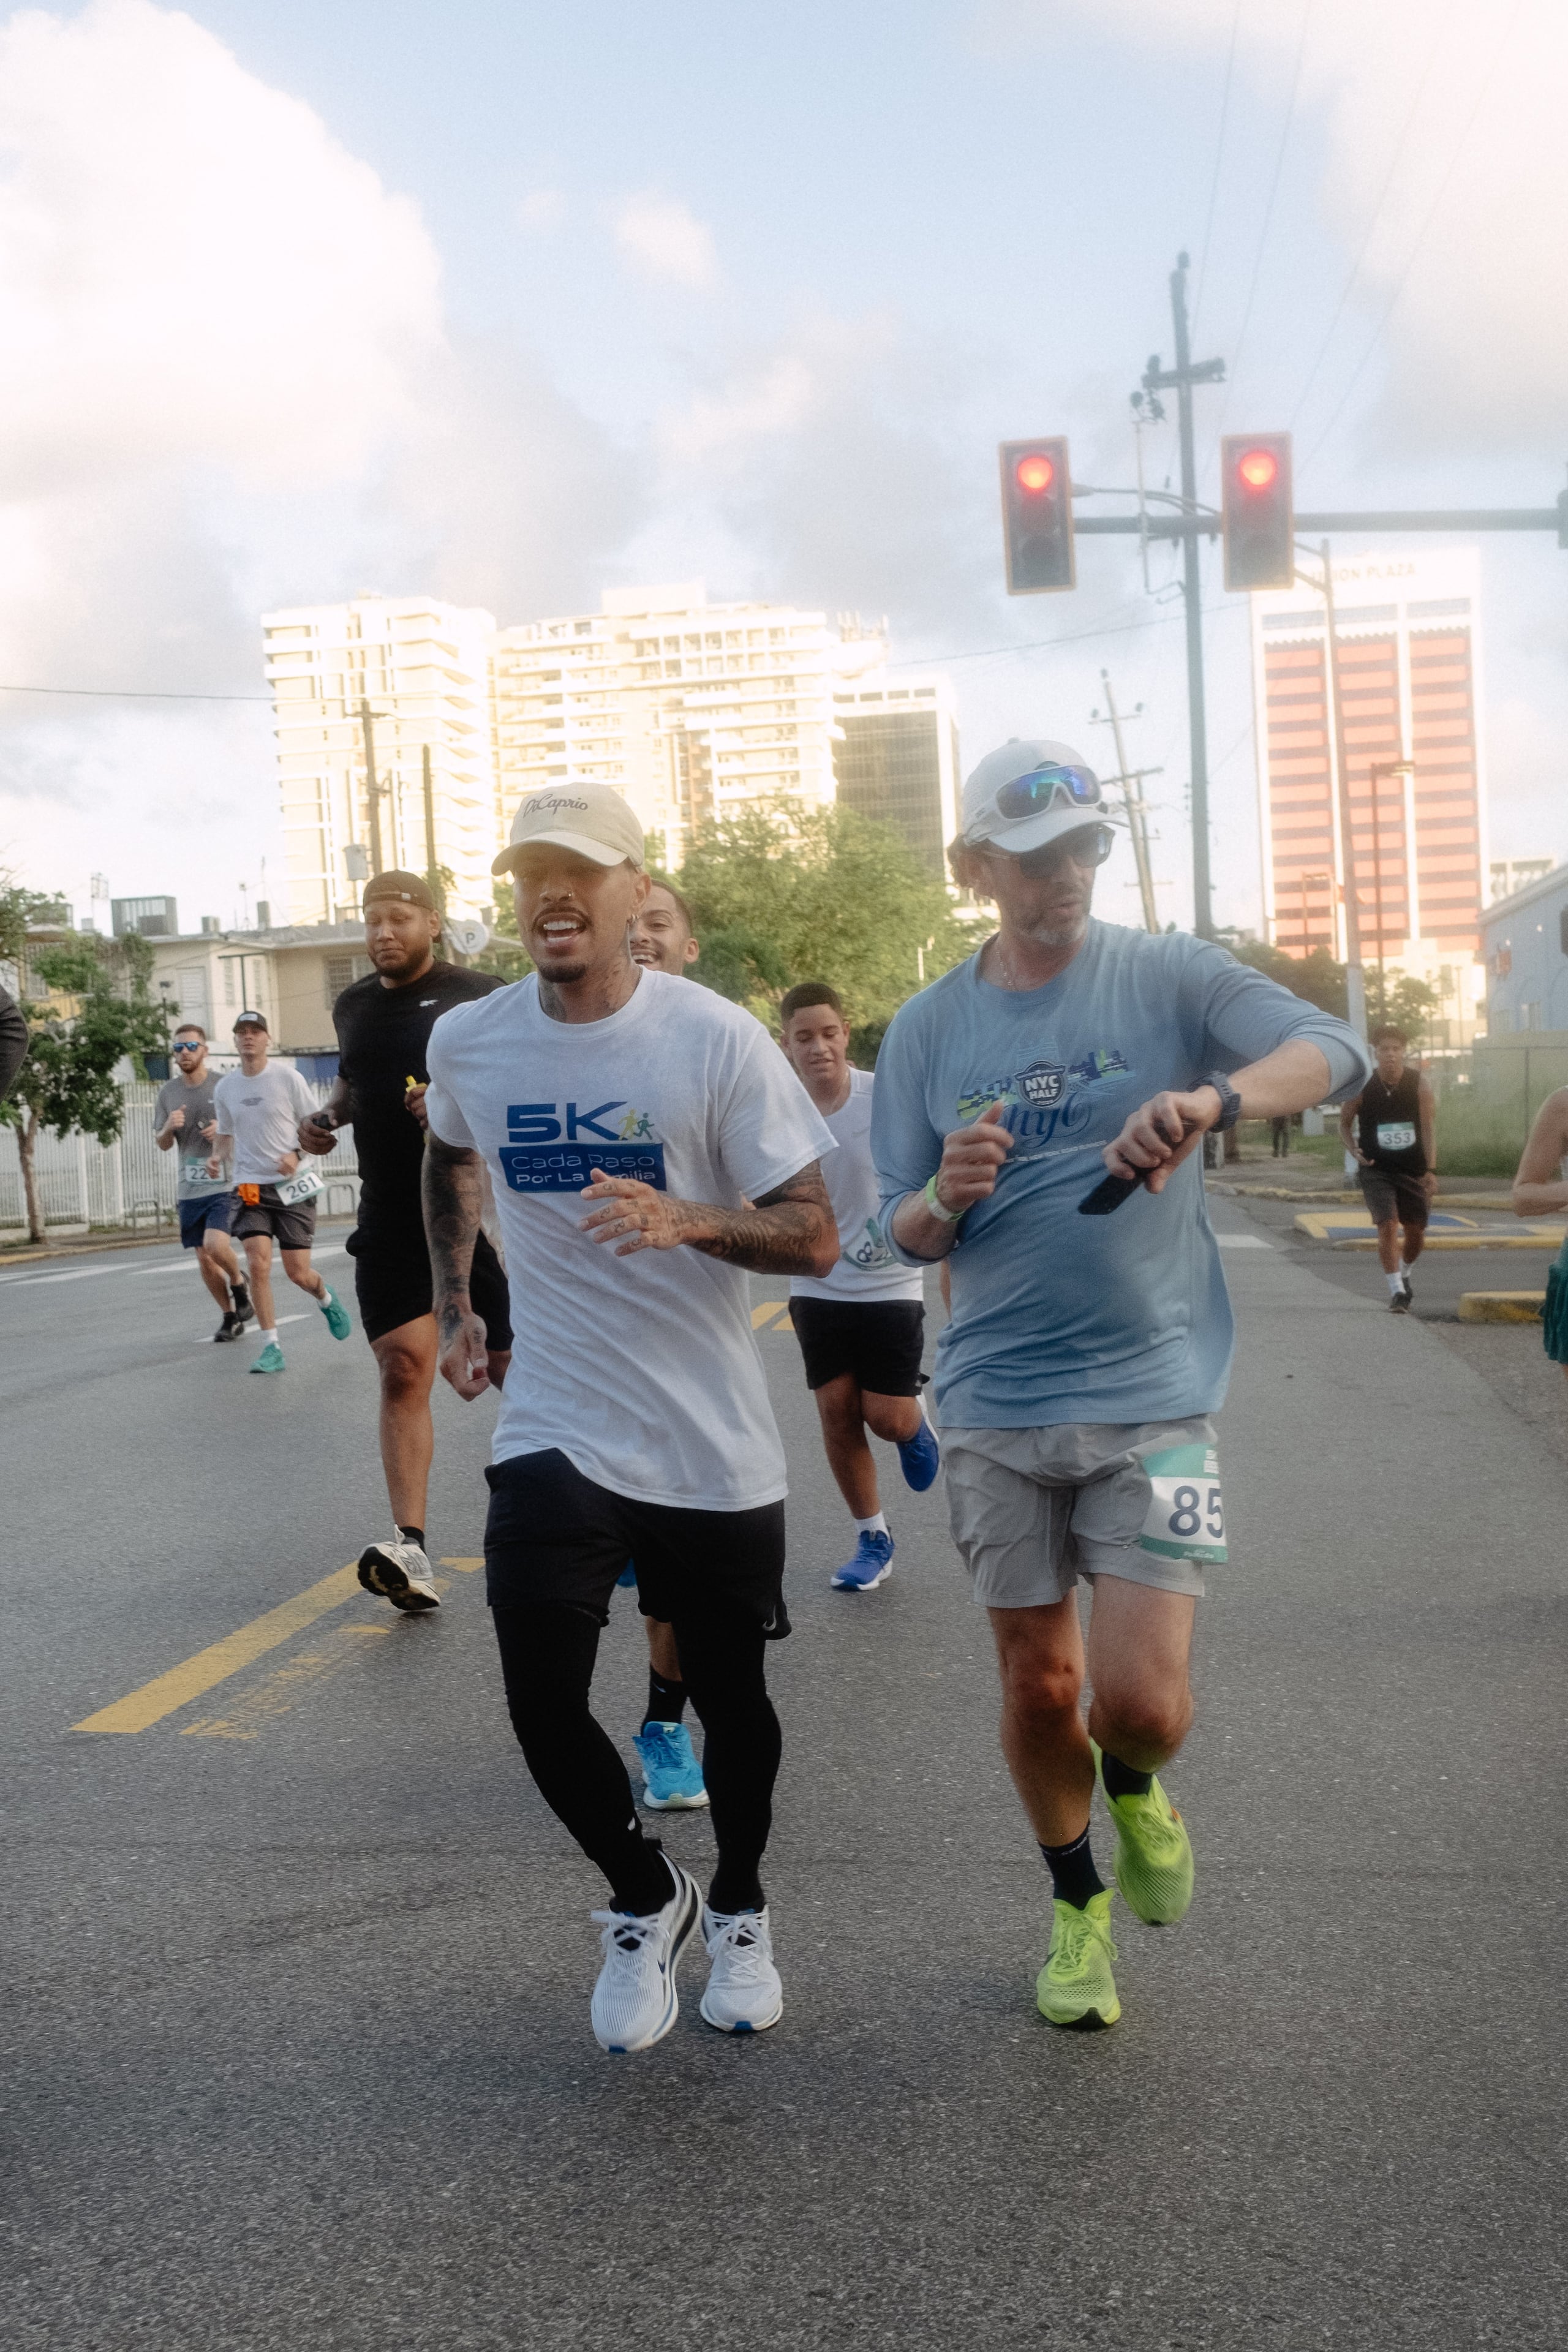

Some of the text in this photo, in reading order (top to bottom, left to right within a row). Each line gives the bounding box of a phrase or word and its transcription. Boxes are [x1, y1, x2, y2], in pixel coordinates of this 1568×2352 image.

[1366, 563, 1415, 579] PLAZA
[522, 793, 589, 818] DiCaprio
[1025, 1075, 1059, 1091] NYC
[1029, 1088, 1058, 1099] HALF
[507, 1101, 628, 1143] 5K
[1384, 1132, 1412, 1145] 353
[511, 1153, 655, 1169] Cada Paso
[190, 1167, 214, 1180] 22
[516, 1174, 552, 1184] Por
[558, 1173, 584, 1183] La
[286, 1176, 317, 1199] 261
